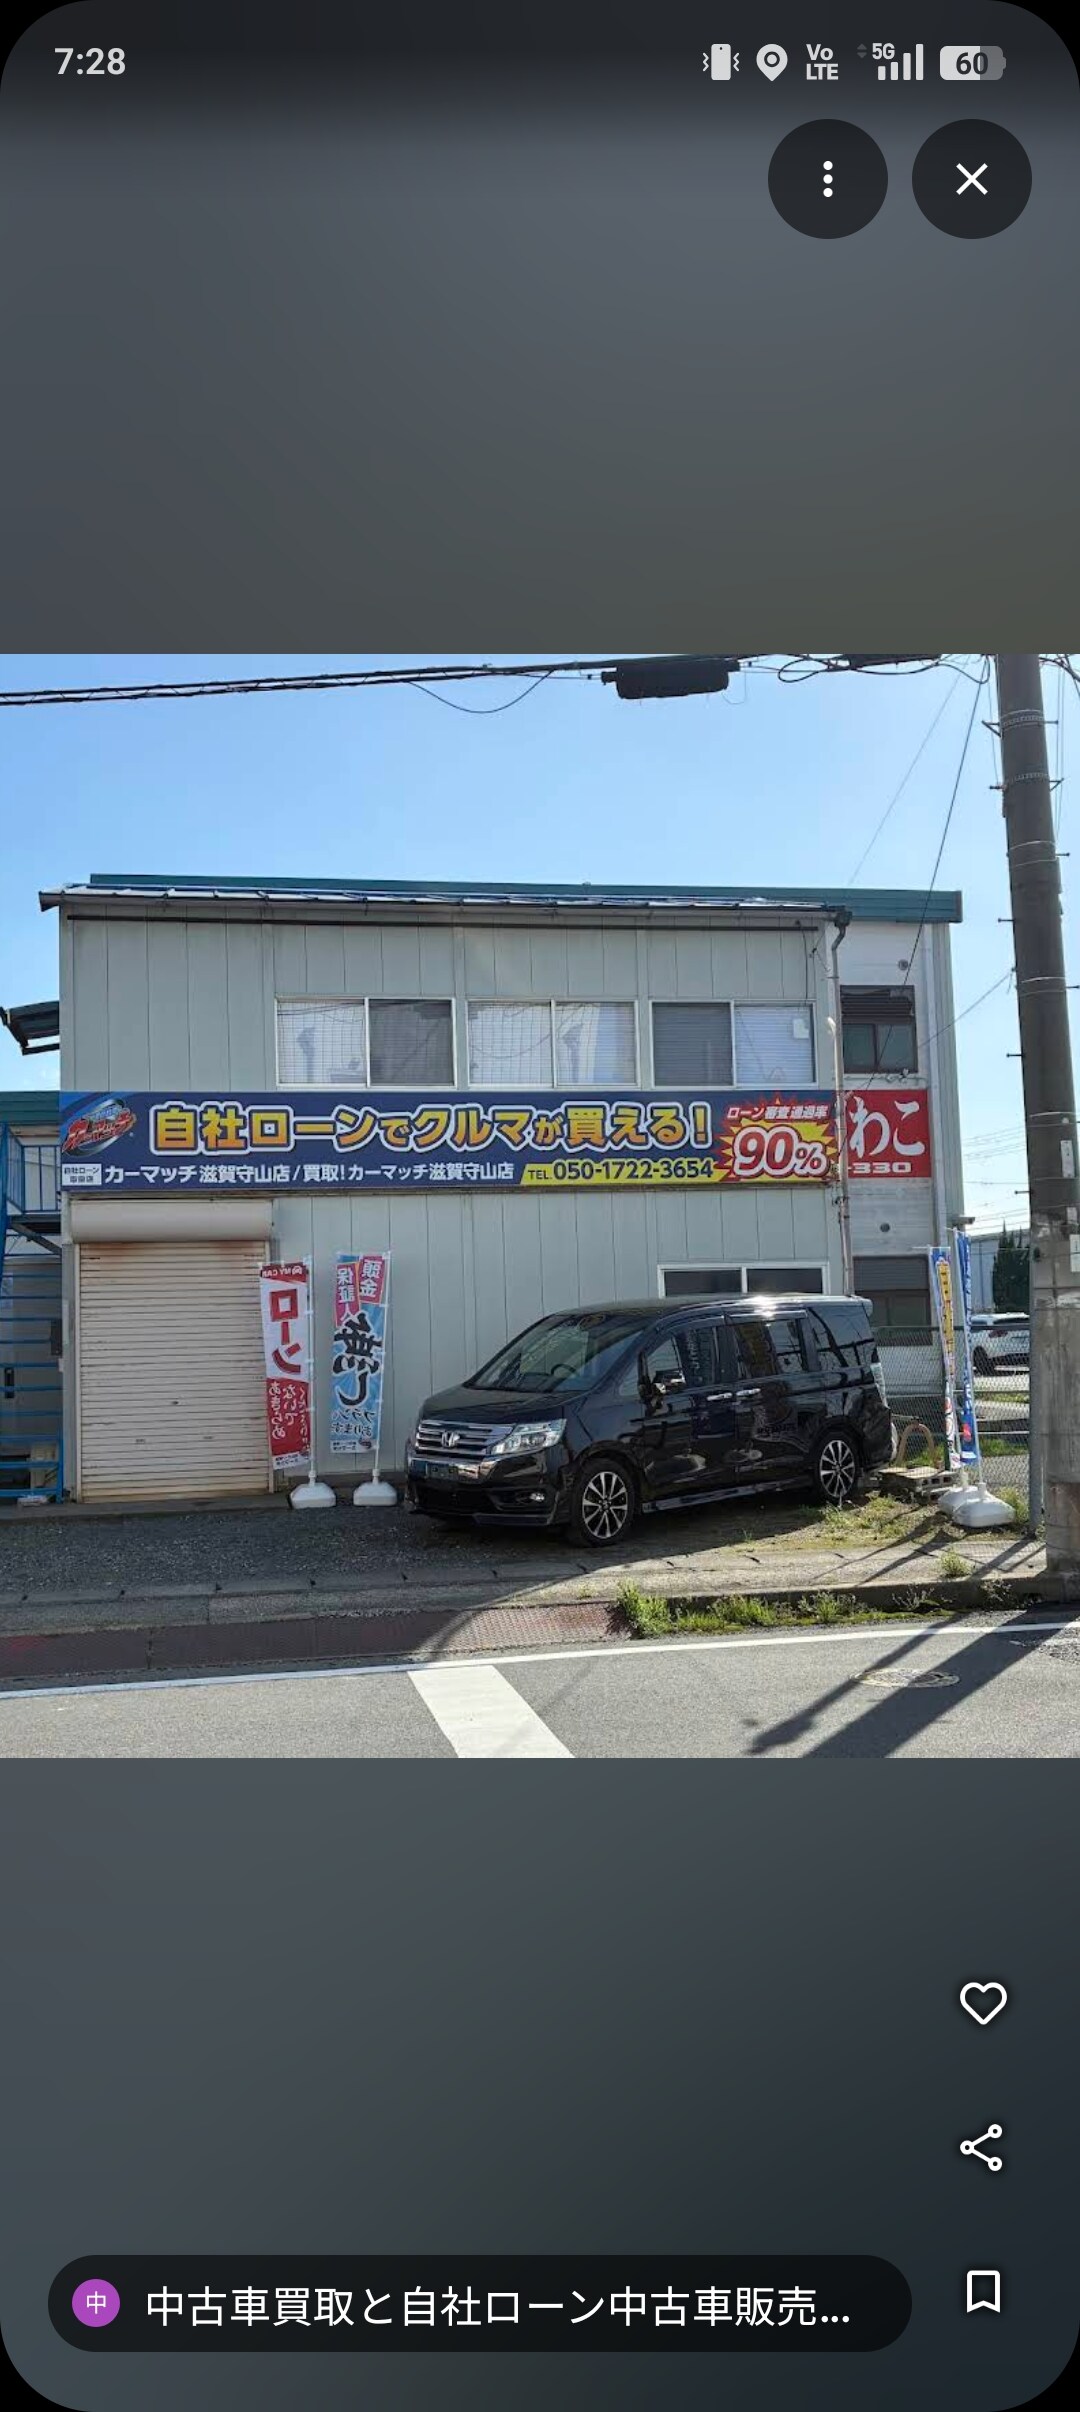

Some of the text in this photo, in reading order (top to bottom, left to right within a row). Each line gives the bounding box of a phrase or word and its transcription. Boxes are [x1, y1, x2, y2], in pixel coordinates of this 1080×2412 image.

[152, 1103, 710, 1153] 自社ローンでクルマが買える!
[735, 1127, 827, 1175] 90%
[836, 1096, 926, 1159] わこ
[553, 1159, 714, 1181] 050-1722-3654
